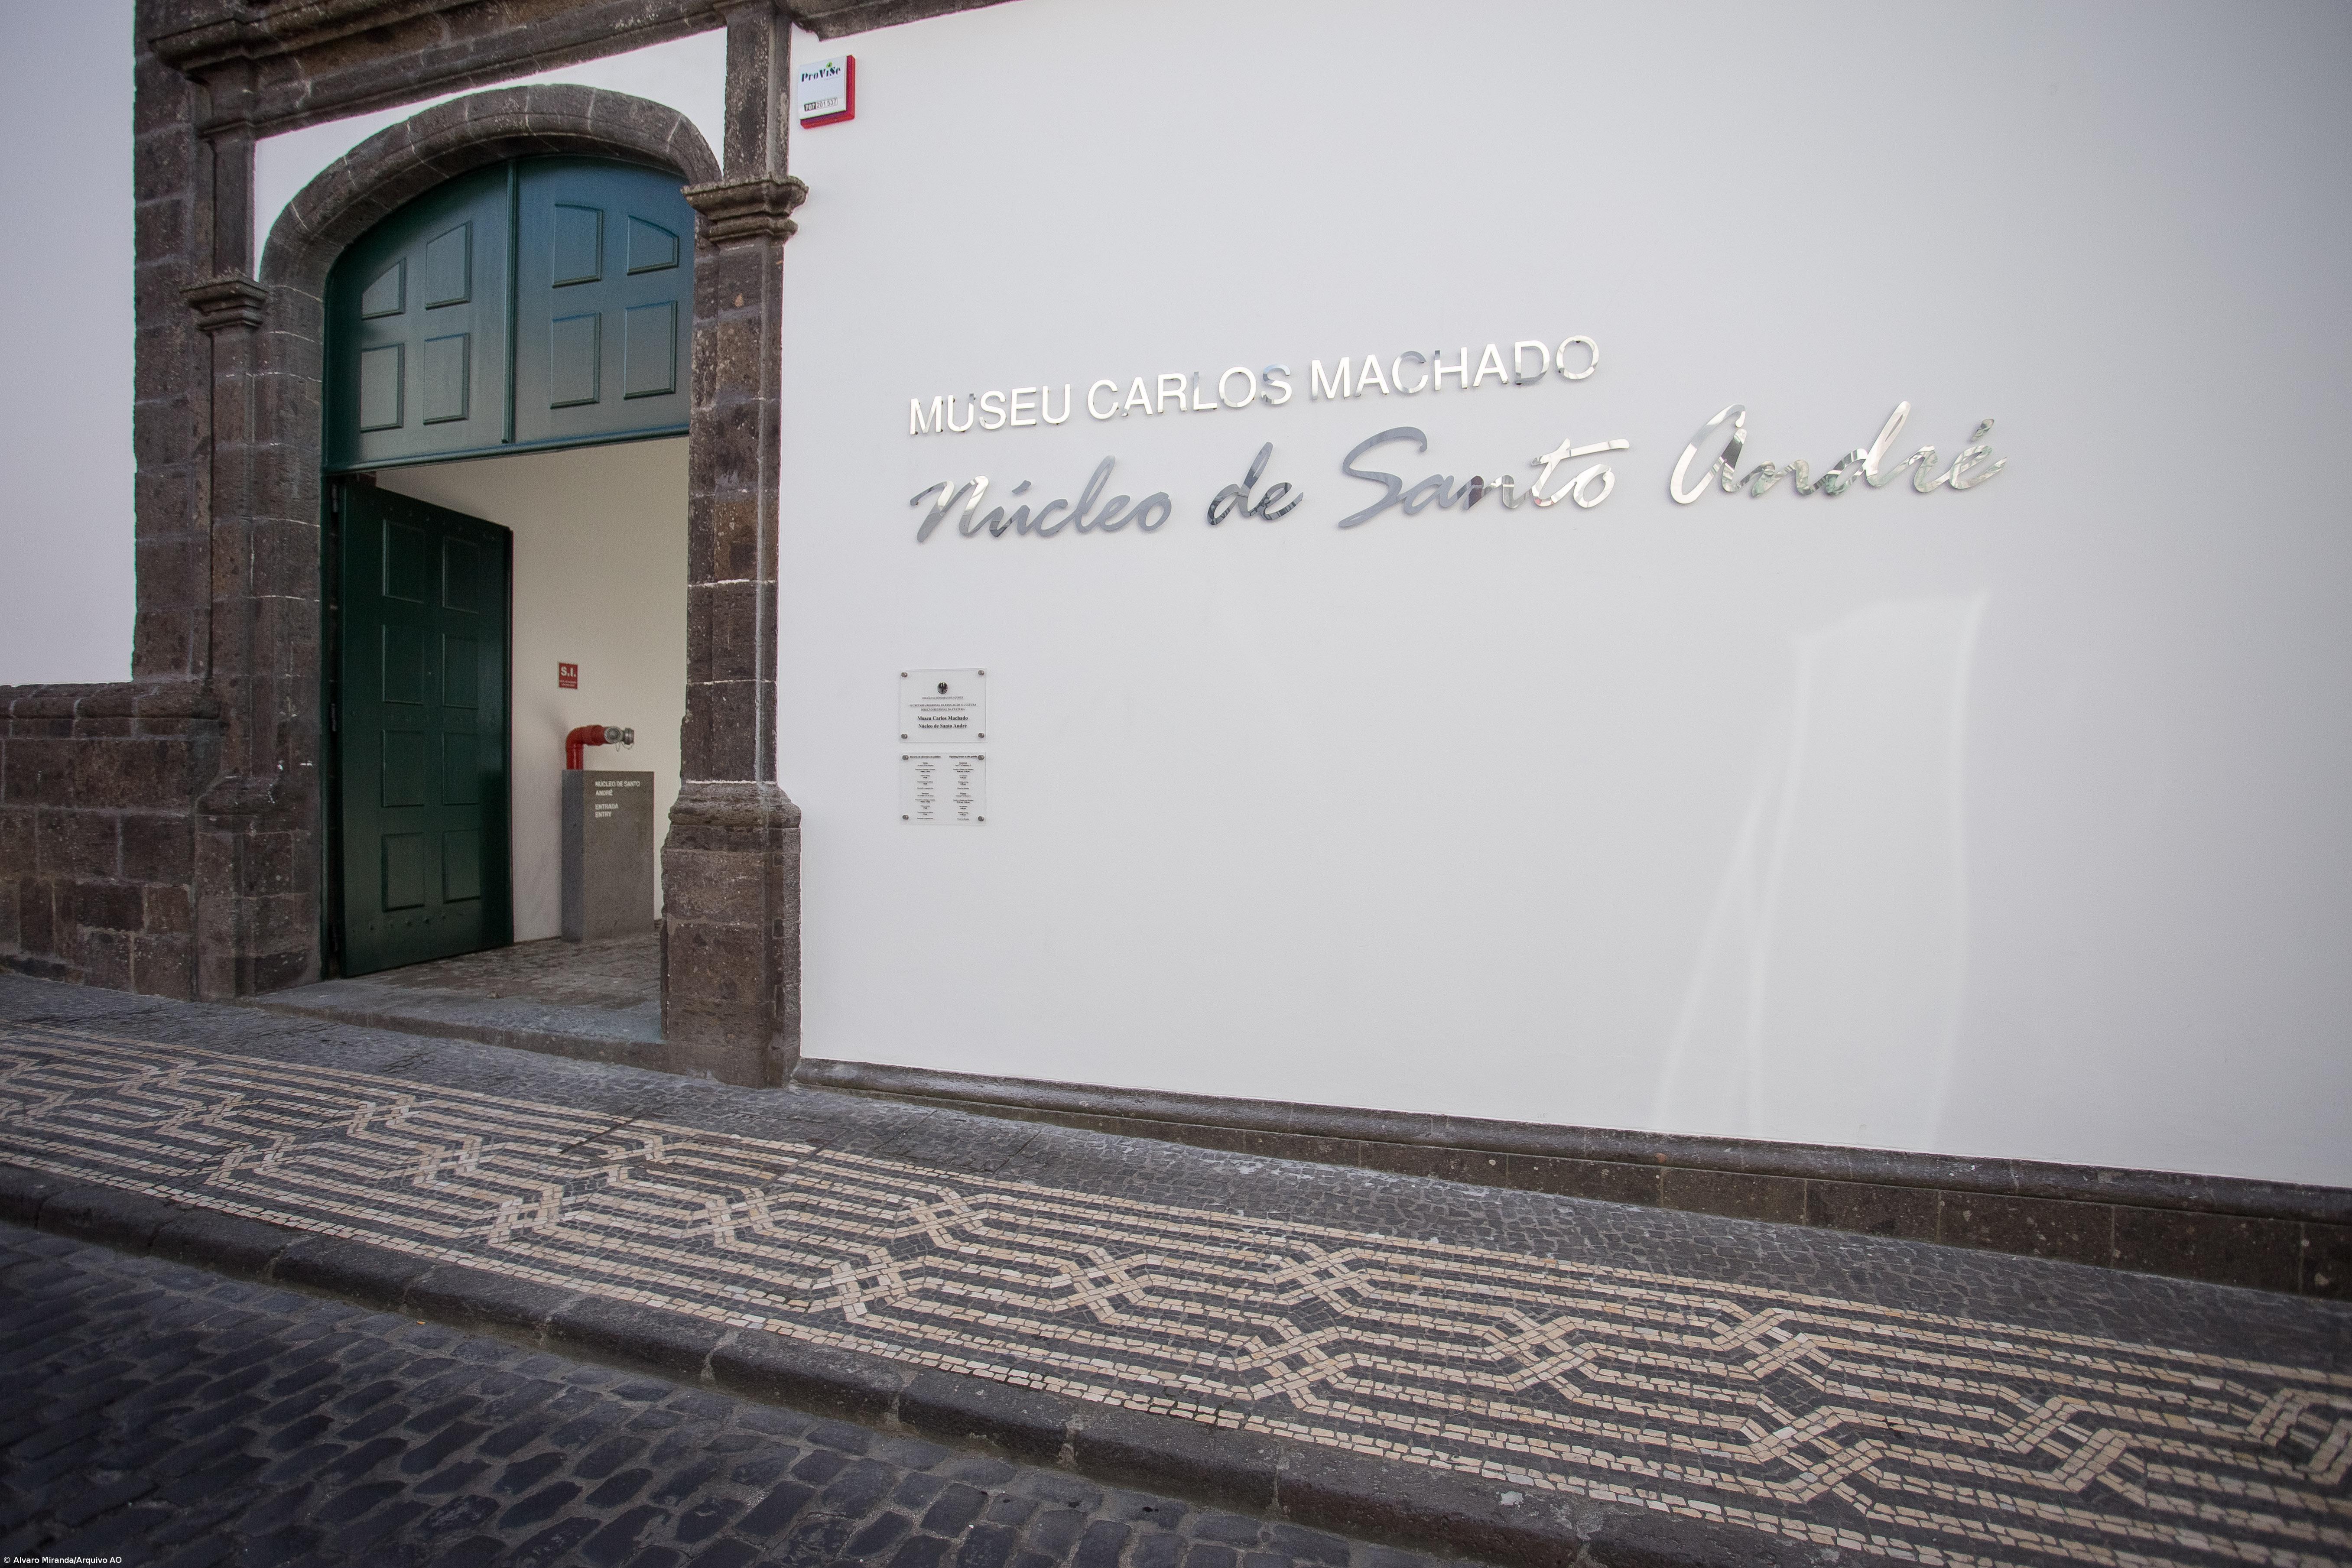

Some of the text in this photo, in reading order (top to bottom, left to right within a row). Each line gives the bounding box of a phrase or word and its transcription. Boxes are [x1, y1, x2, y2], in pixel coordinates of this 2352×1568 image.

[910, 335, 1599, 435] MUSEU CARLOS MACHADO
[910, 401, 2008, 542] Núcleo de Santo André
[561, 666, 576, 677] S.I.
